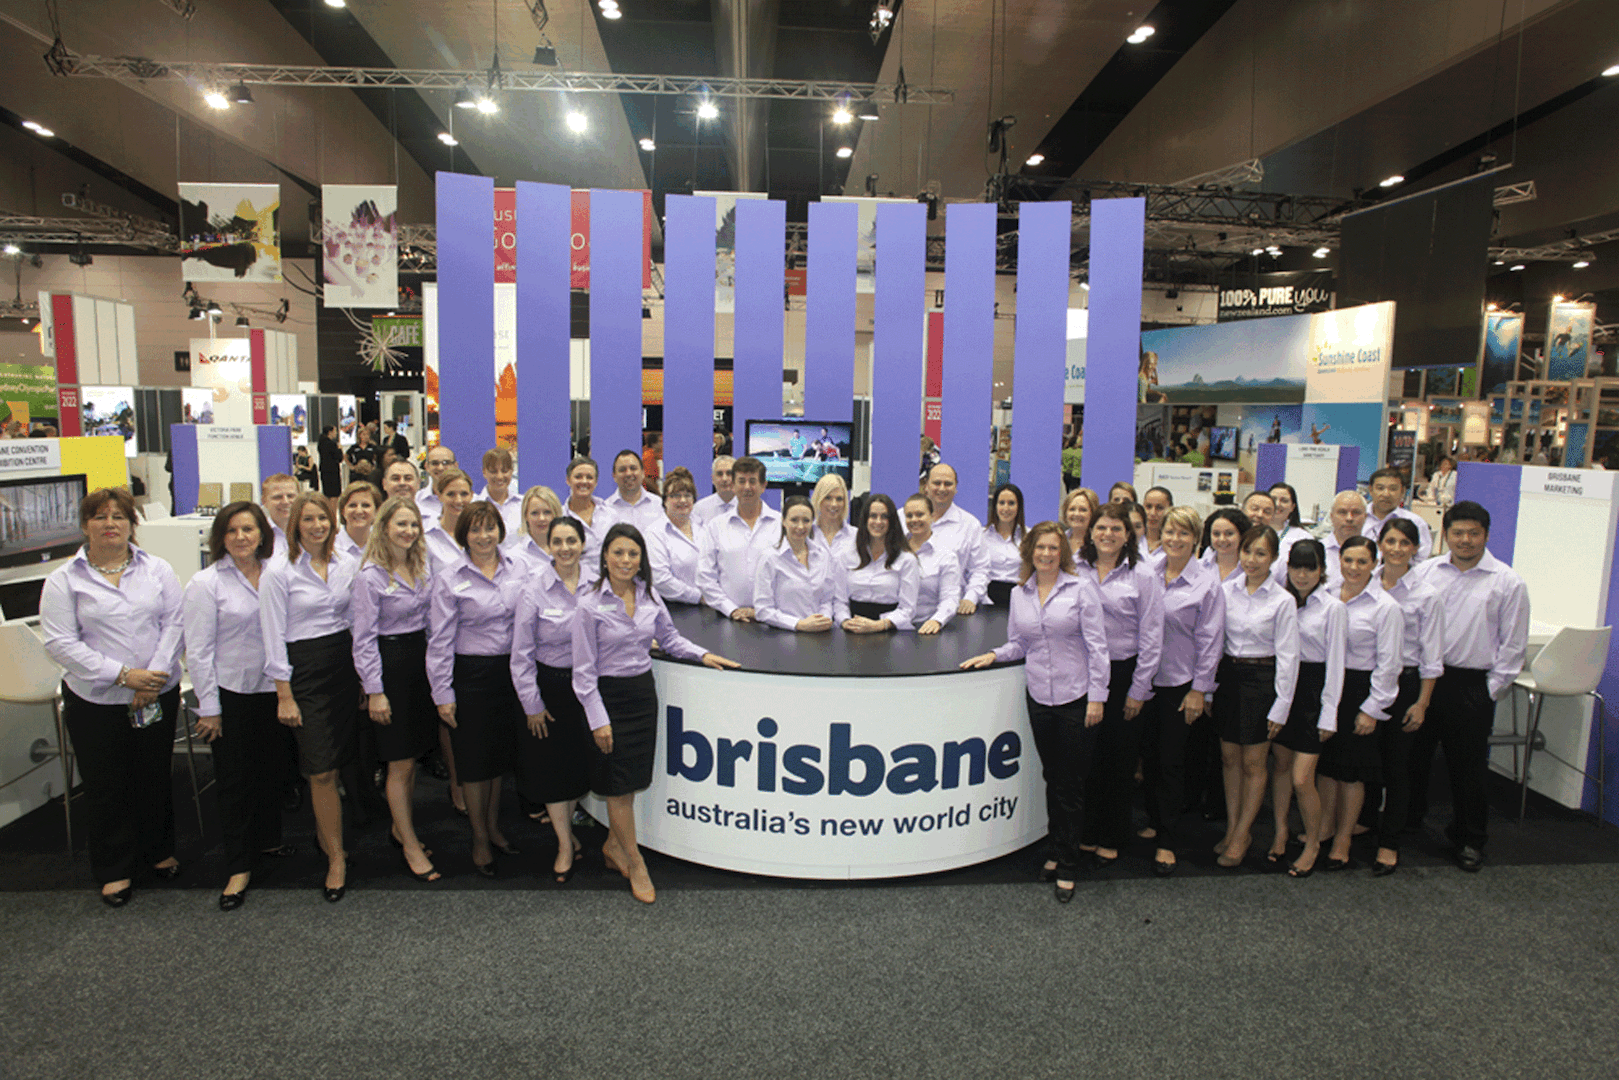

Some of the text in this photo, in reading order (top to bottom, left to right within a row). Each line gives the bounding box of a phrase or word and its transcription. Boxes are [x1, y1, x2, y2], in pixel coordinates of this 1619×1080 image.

[1220, 286, 1328, 312] 100% PURE you
[1318, 346, 1381, 366] Sunshine Coast
[11, 444, 49, 454] CONVENTION
[25, 456, 48, 466] CENTRE
[1548, 472, 1581, 482] BRISBANE
[1544, 484, 1583, 495] MARKETING
[666, 704, 1021, 797] brisbane
[666, 796, 1018, 836] australia's new world city
